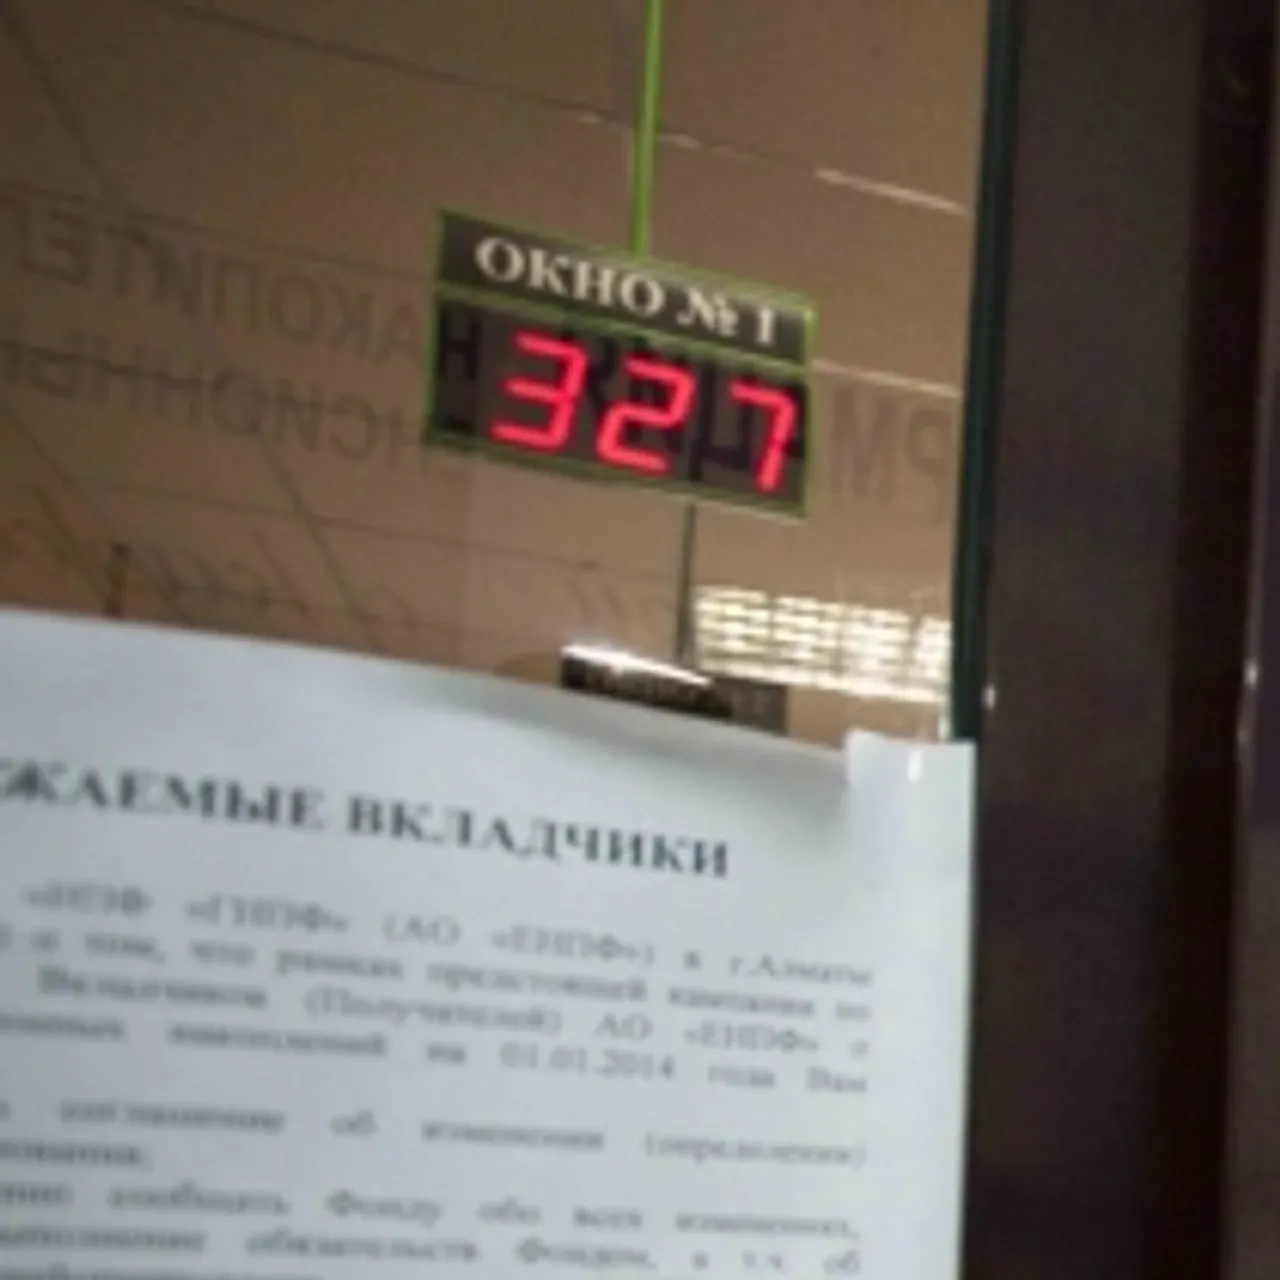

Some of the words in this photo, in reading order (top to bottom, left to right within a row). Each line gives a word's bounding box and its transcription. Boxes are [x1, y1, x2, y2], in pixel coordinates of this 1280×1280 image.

[474, 236, 666, 318] ОКНО
[755, 305, 778, 346] 1
[489, 329, 797, 493] 327
[345, 790, 730, 880] ВКЛАДЧИКИ
